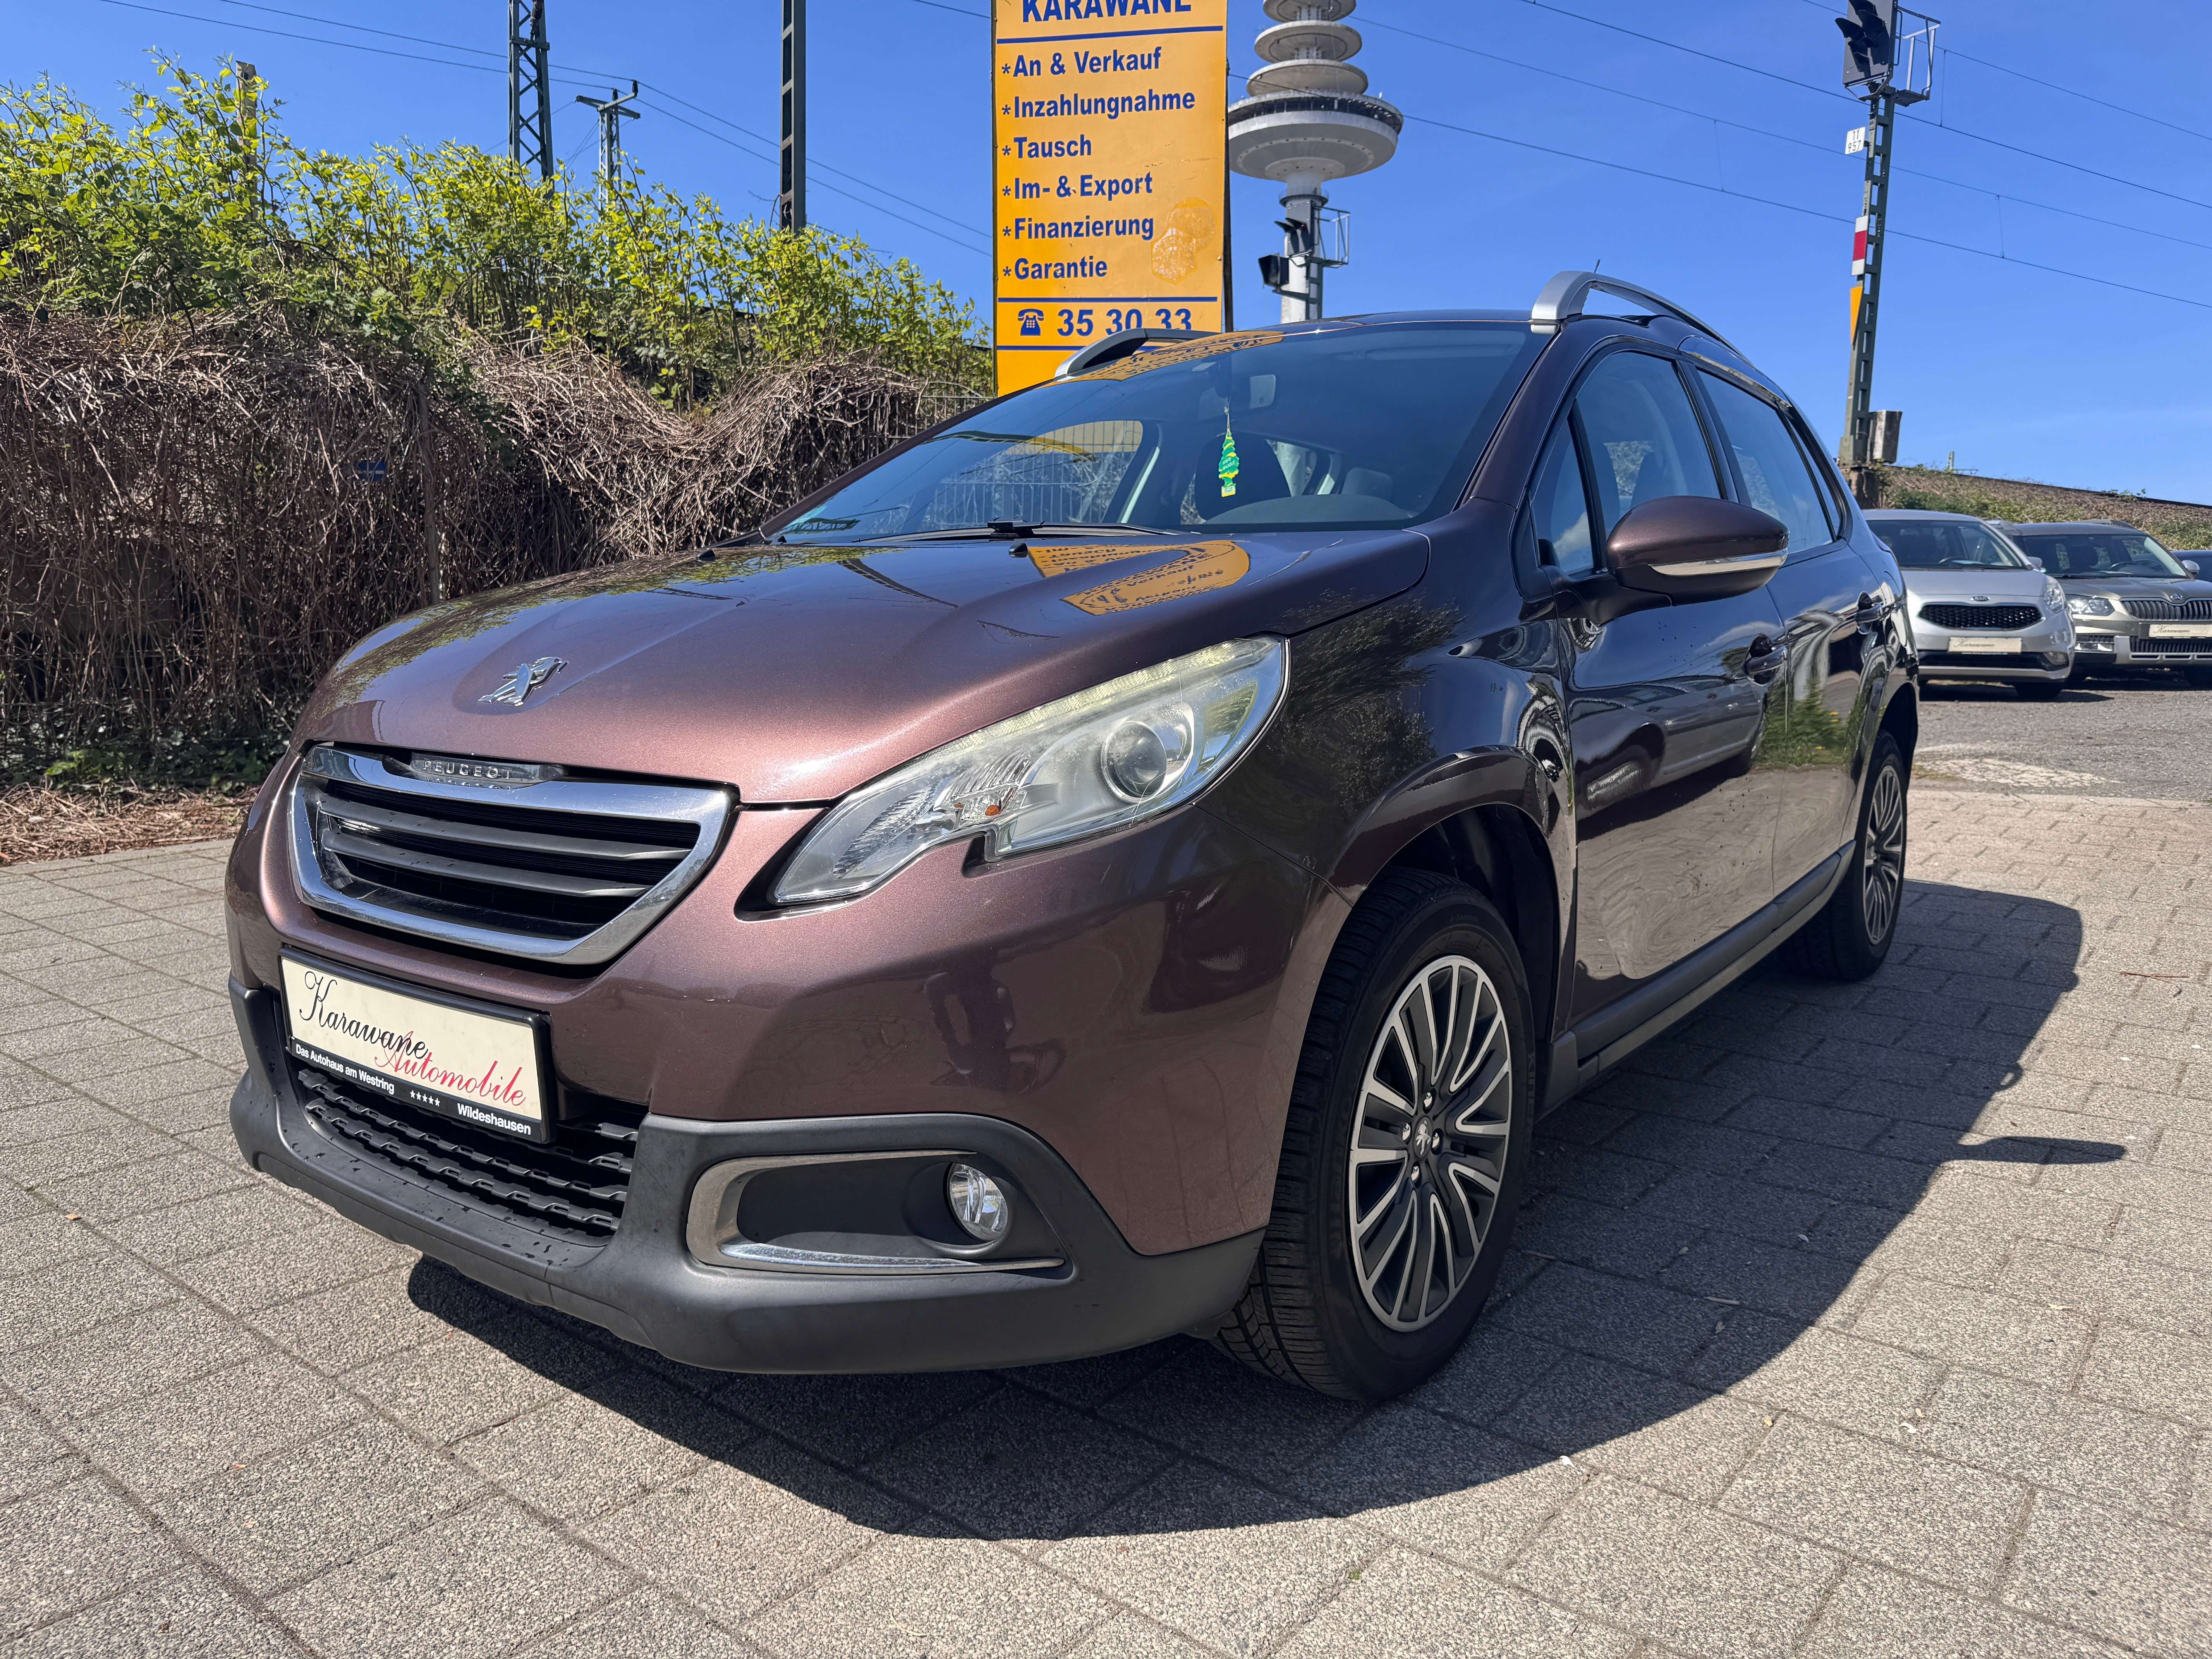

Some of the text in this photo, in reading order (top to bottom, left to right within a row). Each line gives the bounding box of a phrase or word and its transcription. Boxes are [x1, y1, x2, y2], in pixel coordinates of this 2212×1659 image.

[1013, 46, 1162, 77] An & Verkauf
[1014, 89, 1195, 119] Inzahlungnahme
[1013, 134, 1091, 158] Tausch
[1848, 140, 1861, 152] 957
[1853, 130, 1859, 140] 11
[1015, 172, 1152, 201] Im- & Export
[1015, 215, 1153, 240] Finanzierung
[1015, 256, 1108, 280] Garantie
[1057, 308, 1192, 336] 35 30 33
[423, 759, 514, 780] PEUGEOT
[300, 971, 429, 1059] Karawane
[374, 1030, 526, 1106] Automobile
[296, 1044, 531, 1135] Das Autohaus am Westring Wildeshausen
